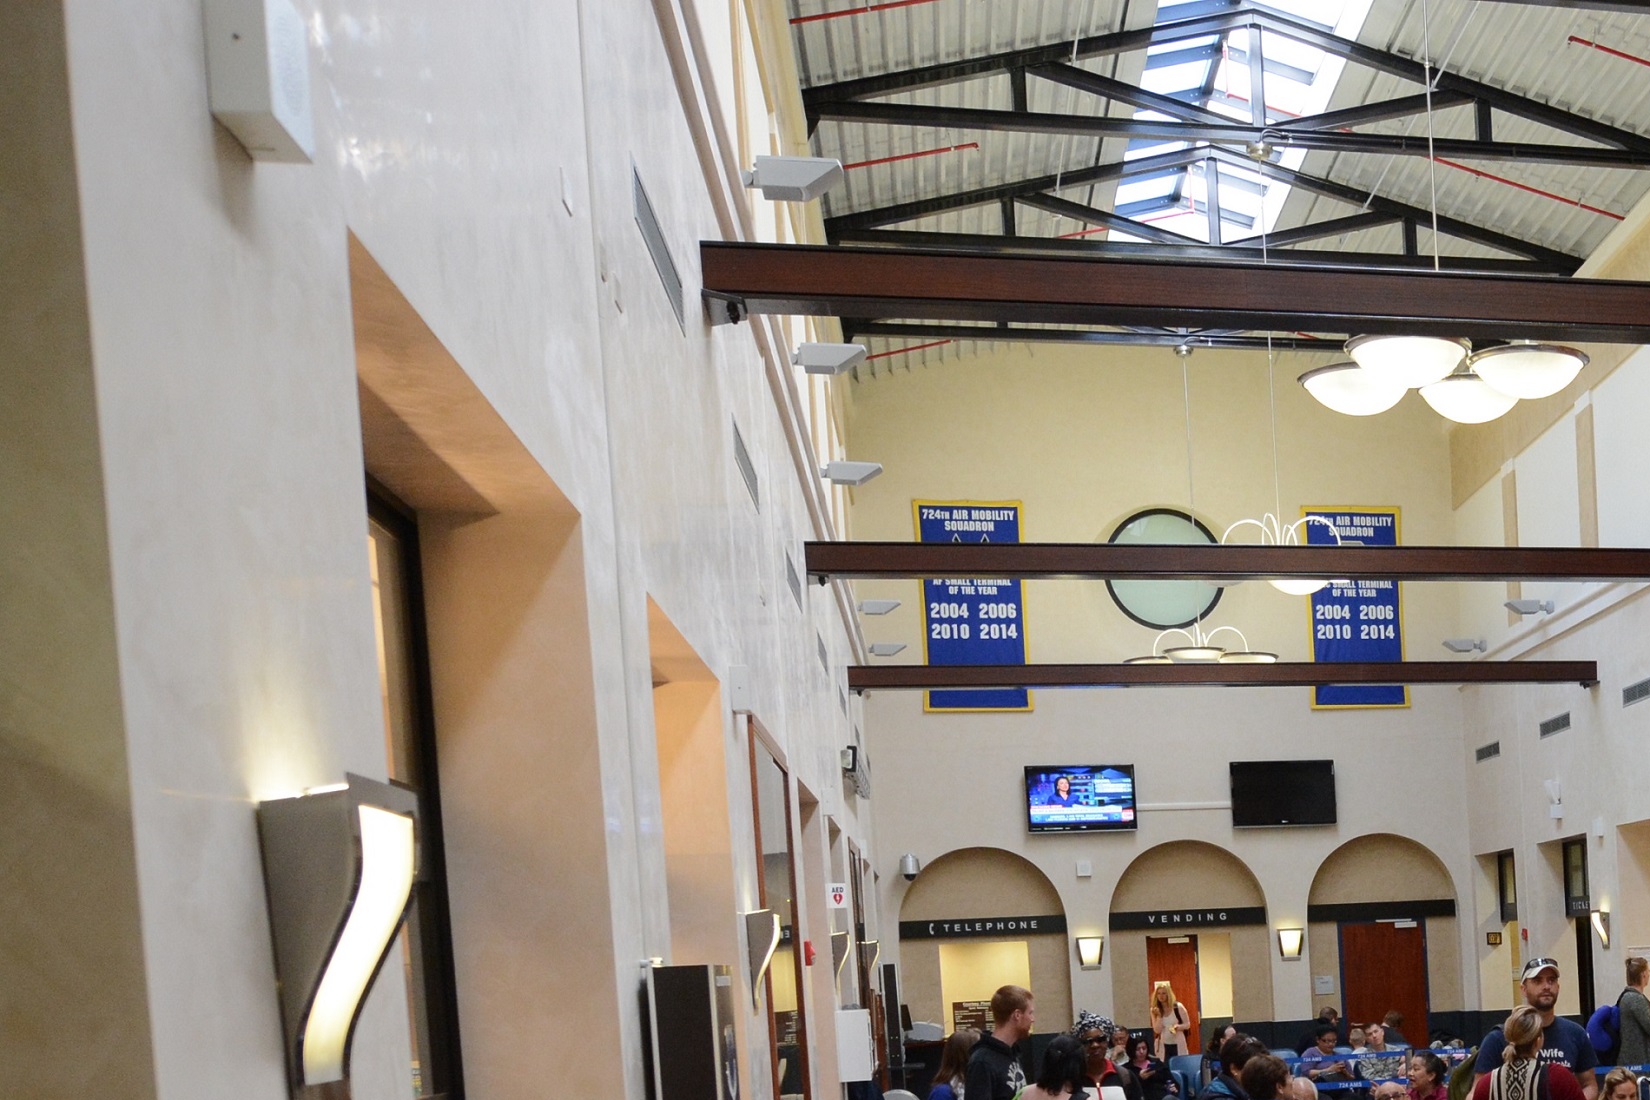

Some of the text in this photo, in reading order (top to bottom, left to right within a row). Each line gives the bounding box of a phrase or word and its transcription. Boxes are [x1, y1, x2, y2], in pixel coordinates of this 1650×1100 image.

[952, 510, 968, 520] AIR
[971, 510, 1014, 520] MOBILITY
[1336, 516, 1350, 526] AIR
[1353, 517, 1393, 526] MOBILITY
[944, 521, 994, 532] SQUADRON
[1328, 527, 1374, 537] SQUADRON
[1358, 580, 1393, 589] TERMINAL
[948, 586, 998, 595] OF THE YEAR
[1332, 588, 1377, 597] OF THE YEAR
[930, 602, 1017, 619] 2004 2006
[1316, 604, 1394, 620] 2004 2006
[931, 623, 1018, 640] 2010 2014
[1317, 624, 1395, 640] 2010 2014
[1148, 912, 1227, 924] VENDING
[943, 920, 1038, 932] TELEPHONE
[1540, 1048, 1564, 1058] Wife
